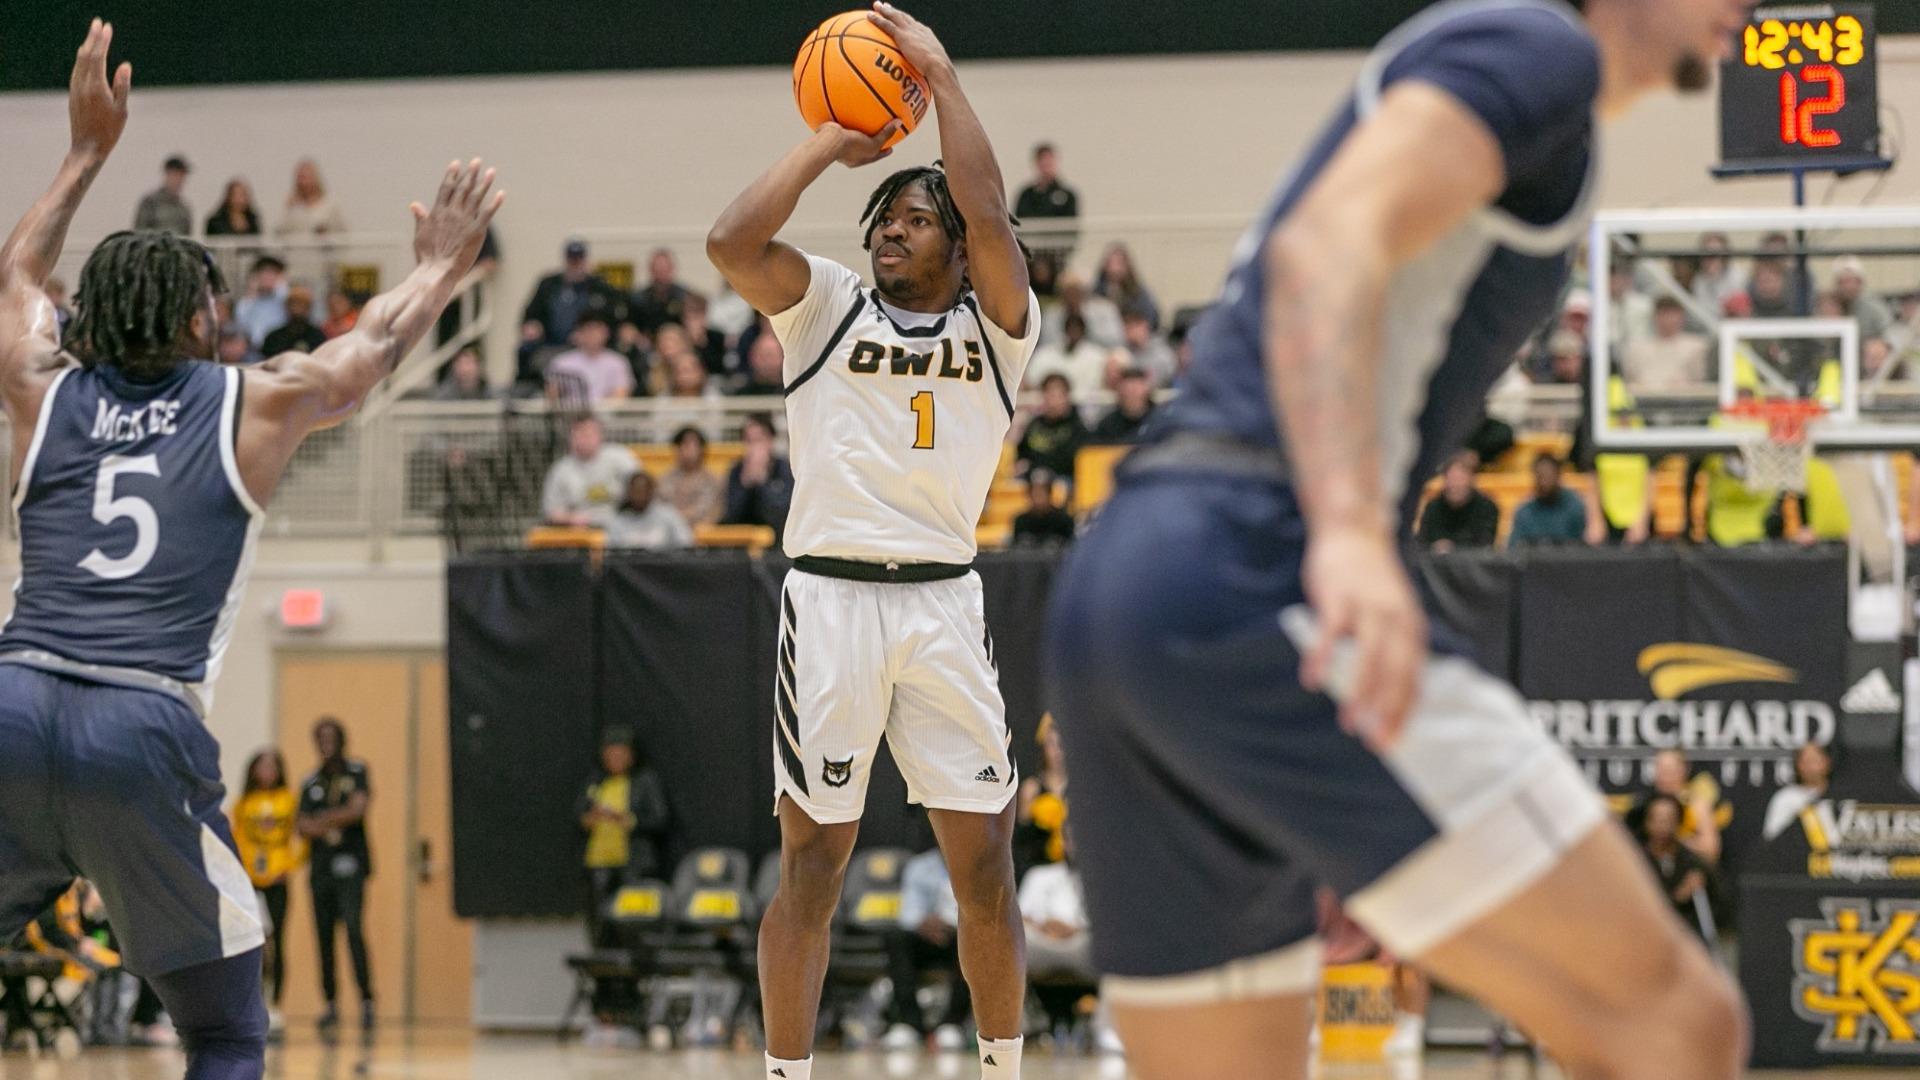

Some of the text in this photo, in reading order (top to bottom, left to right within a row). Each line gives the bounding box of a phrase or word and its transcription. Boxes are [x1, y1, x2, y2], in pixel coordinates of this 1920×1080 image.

[1744, 15, 1864, 70] 12:43
[874, 51, 930, 126] Wilson
[1779, 64, 1845, 148] 12
[848, 337, 983, 382] OWLS
[910, 390, 935, 450] 1
[76, 453, 161, 580] 5
